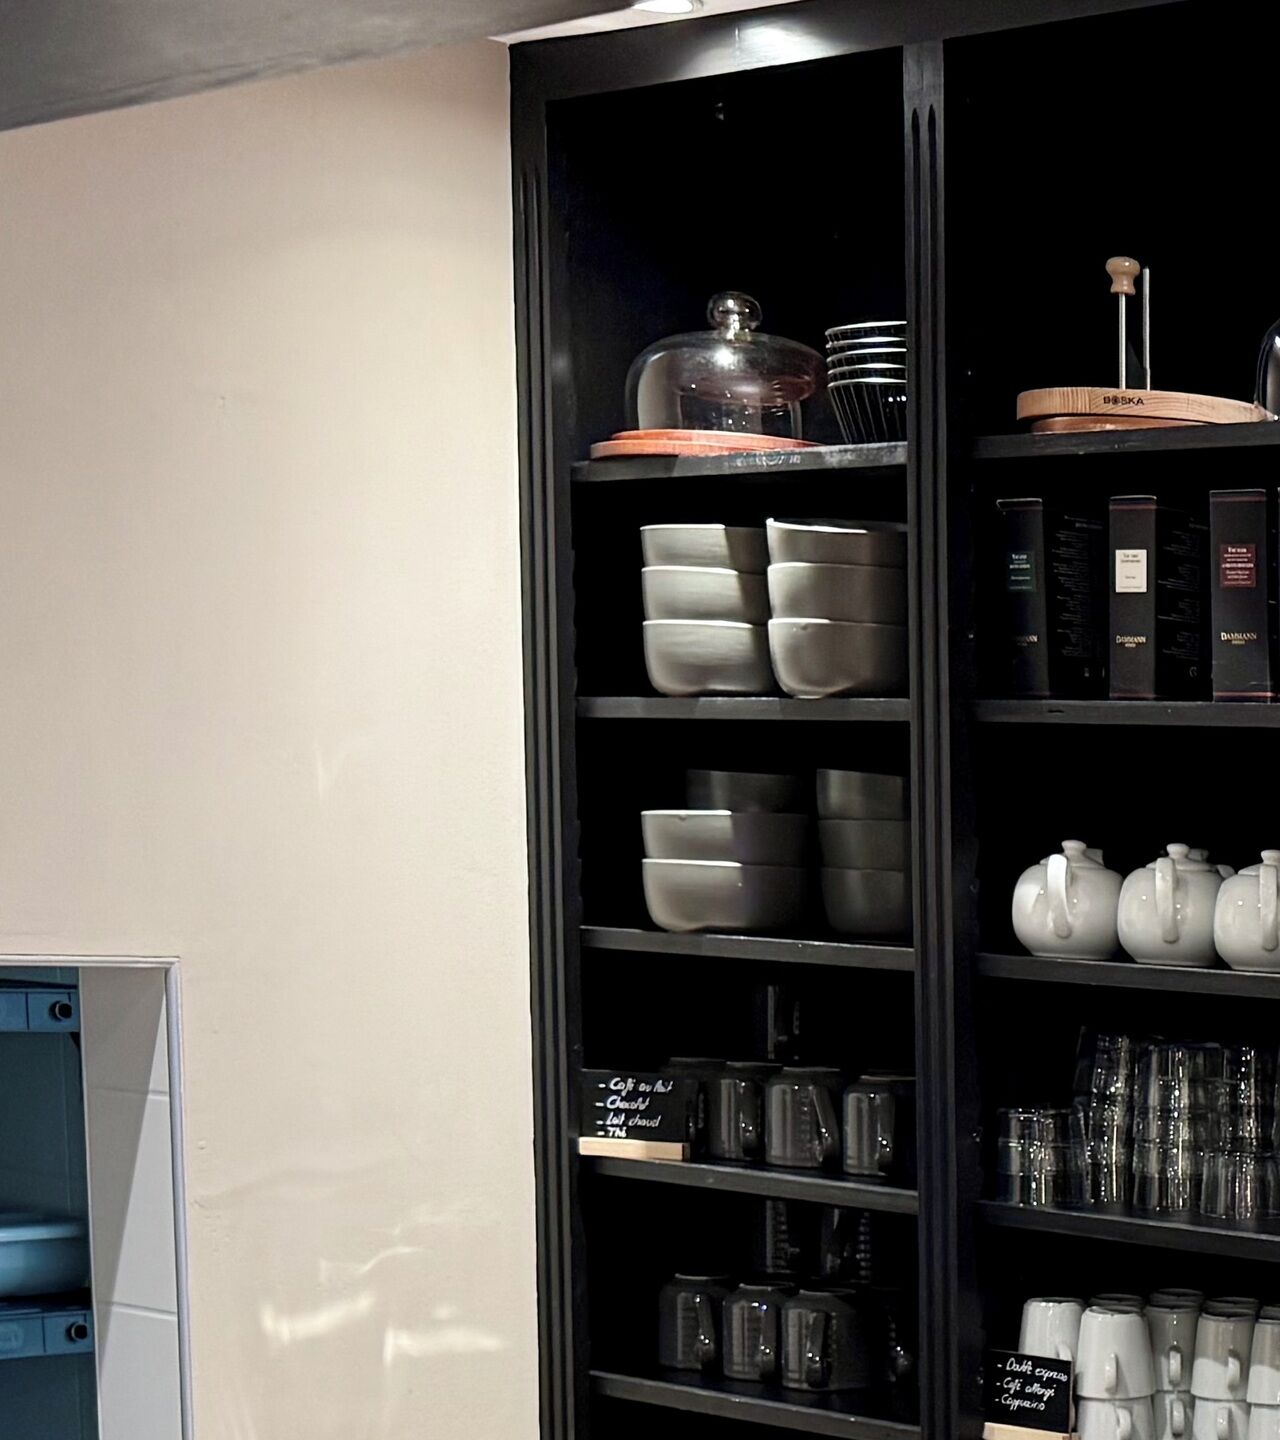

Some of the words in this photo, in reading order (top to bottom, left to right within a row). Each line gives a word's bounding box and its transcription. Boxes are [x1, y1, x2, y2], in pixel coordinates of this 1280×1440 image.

[606, 1095, 650, 1110] Chocolat
[606, 1112, 625, 1125] Lait
[628, 1114, 661, 1127] chaud
